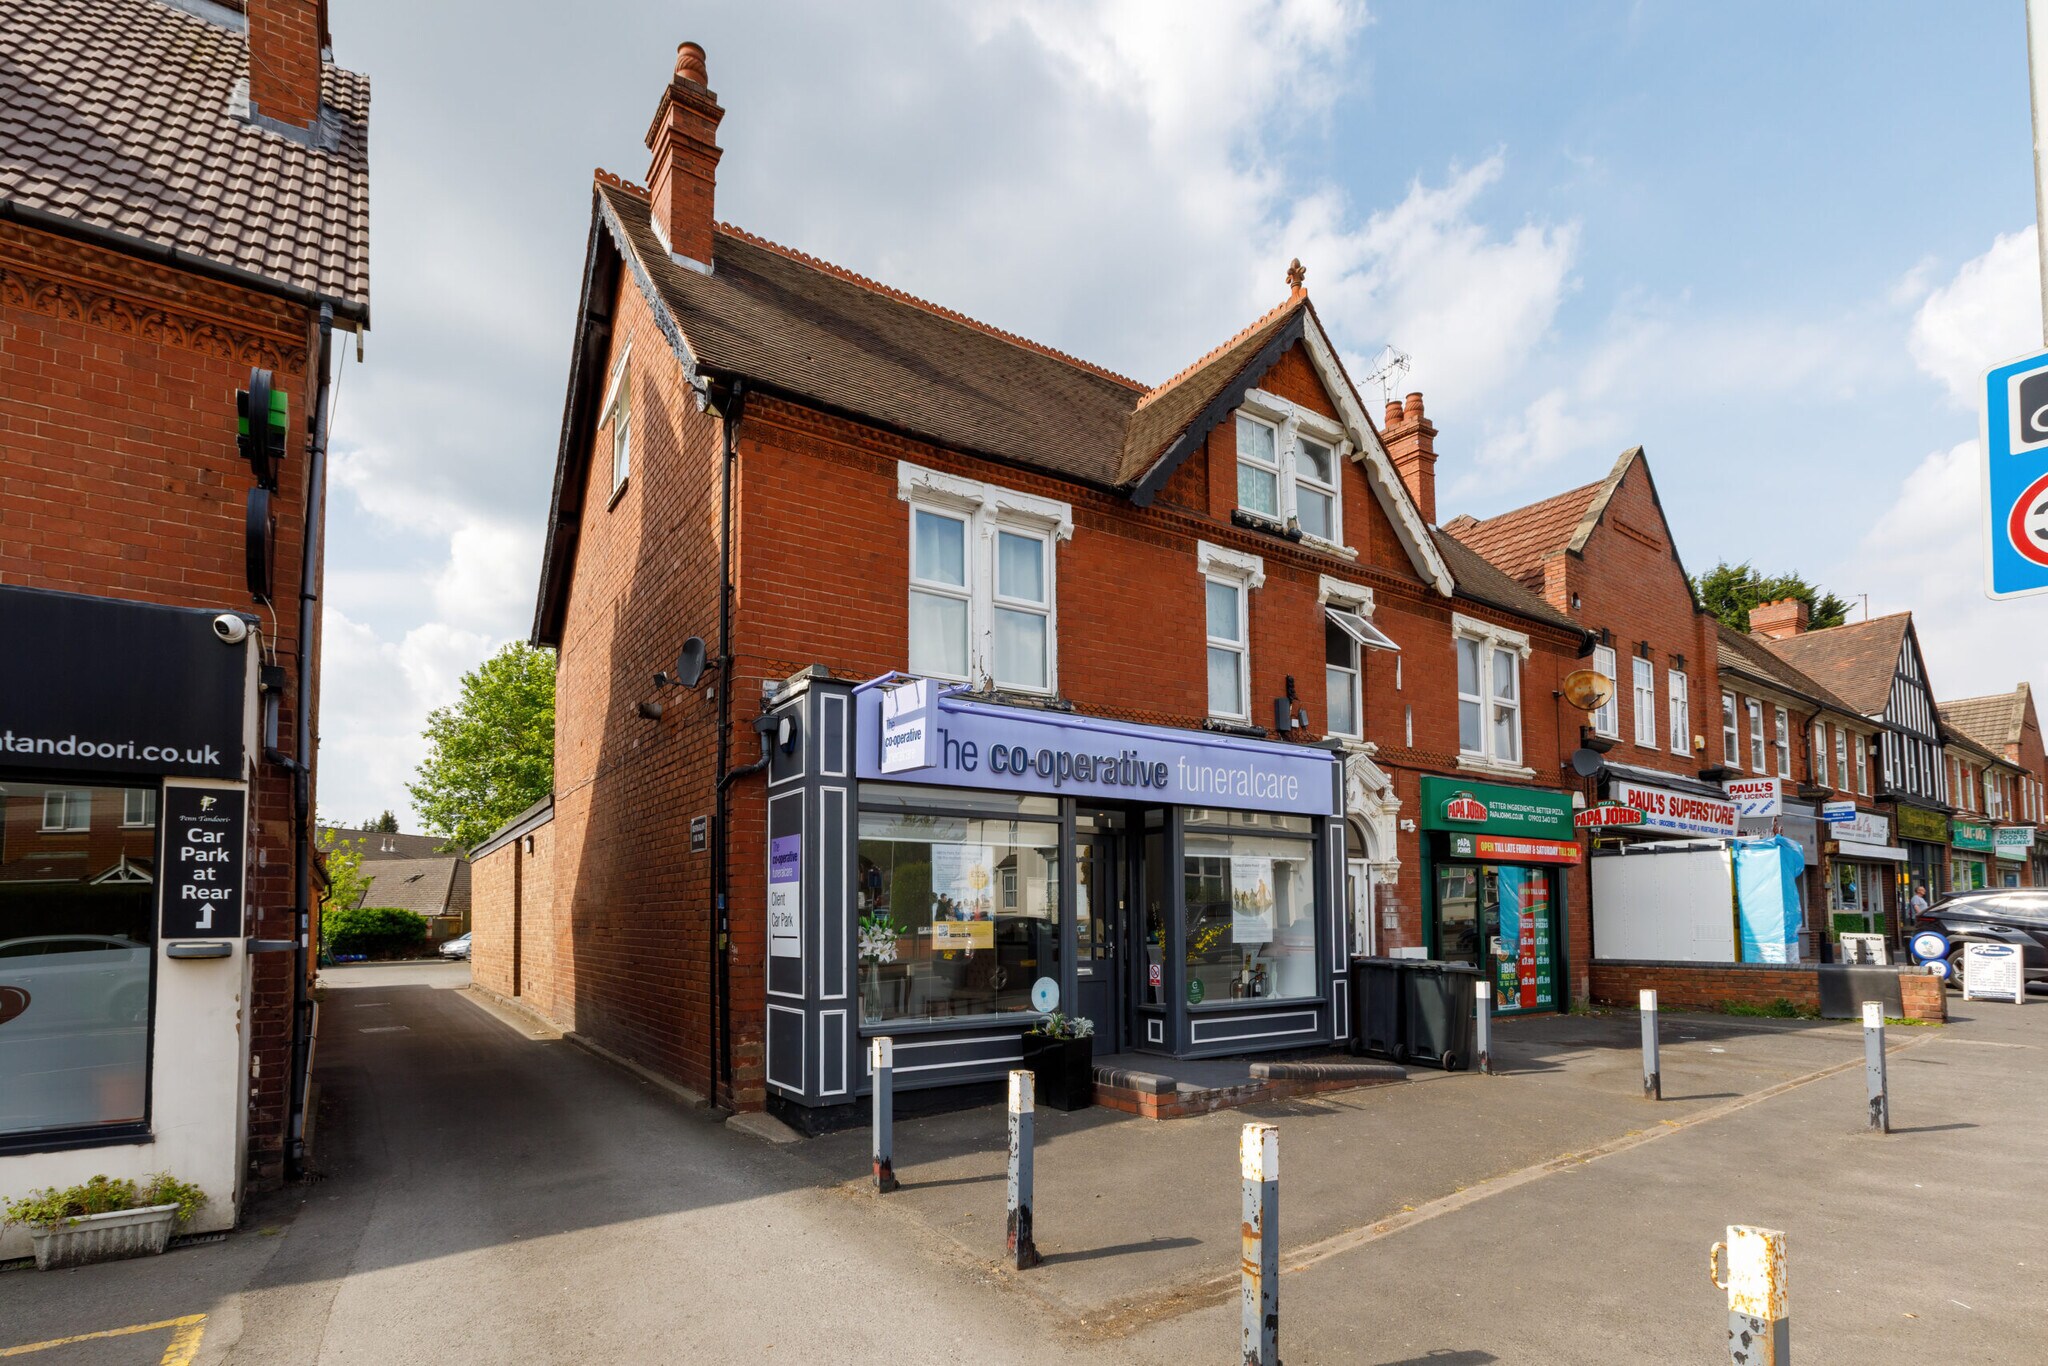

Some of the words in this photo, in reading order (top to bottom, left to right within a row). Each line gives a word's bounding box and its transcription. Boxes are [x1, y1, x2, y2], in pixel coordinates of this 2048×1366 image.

[885, 729, 922, 748] co-operative
[988, 743, 1168, 787] co-operative
[1178, 756, 1299, 800] funeralcare
[1729, 782, 1773, 794] PAUL'S
[1448, 801, 1465, 819] PAPA
[1465, 802, 1487, 821] JOHNS
[1489, 801, 1506, 810] BETTER
[1536, 806, 1551, 815] BETTER
[1628, 789, 1665, 815] PAUL'S
[1669, 796, 1735, 826] SUPERSTORE
[1574, 809, 1602, 827] PAPA
[1604, 807, 1641, 825] JOHNS
[187, 828, 225, 843] Car
[1457, 838, 1471, 847] PAPA
[181, 846, 230, 863] Park
[1457, 846, 1471, 854] JOHNS
[1480, 841, 1494, 852] OPEN
[1495, 842, 1504, 852] TILL
[1505, 843, 1515, 853] LATE
[1516, 843, 1532, 854] FRIDAY
[772, 850, 798, 866] co-operative
[193, 867, 217, 880] at
[181, 885, 233, 900] Rear
[772, 891, 786, 907] Client
[771, 912, 781, 928] Car
[782, 912, 793, 927] Park
[1504, 962, 1516, 973] BIG
